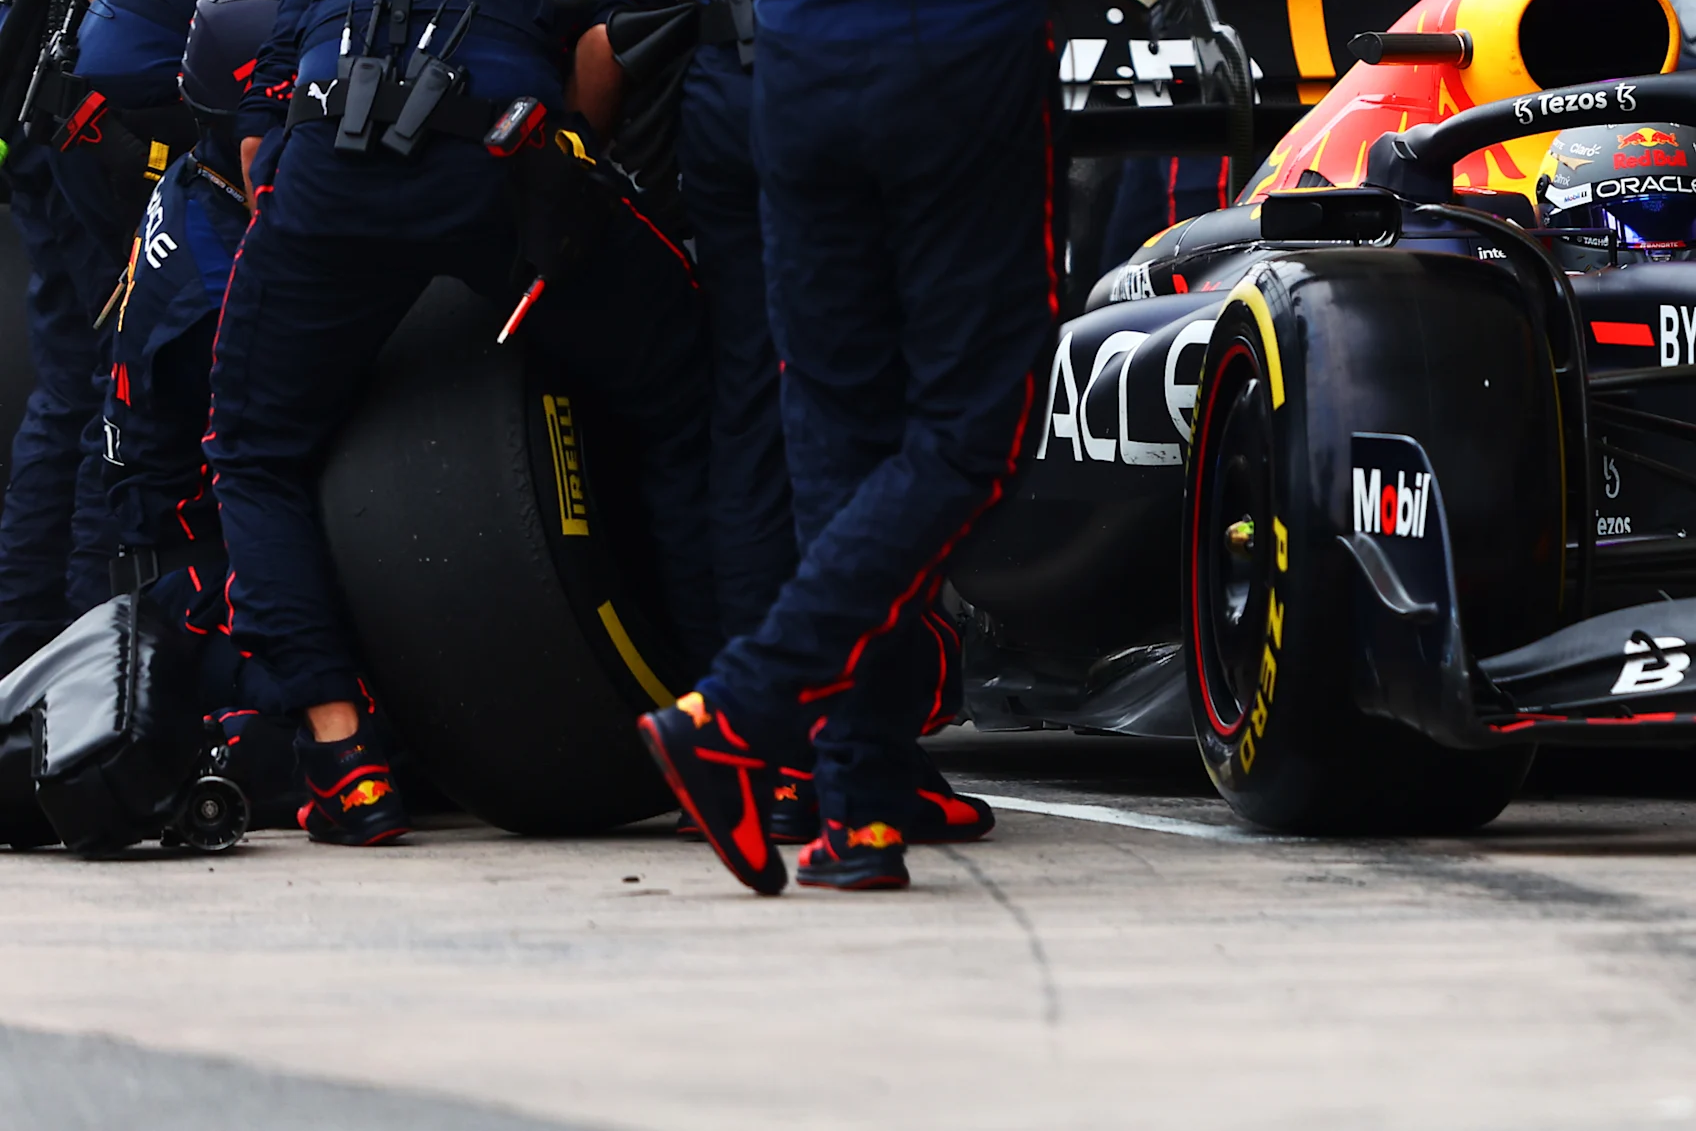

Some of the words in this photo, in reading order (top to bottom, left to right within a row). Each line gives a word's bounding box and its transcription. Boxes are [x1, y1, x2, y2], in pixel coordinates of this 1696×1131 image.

[1538, 90, 1607, 115] Tezos
[1570, 143, 1600, 157] Claro
[1613, 150, 1649, 170] Red
[1651, 148, 1687, 167] Bull
[1477, 247, 1507, 260] inte
[1036, 319, 1218, 466] ACLE
[543, 394, 589, 536] PIRELLI
[1352, 467, 1432, 539] Mobil
[1595, 510, 1631, 535] ezos
